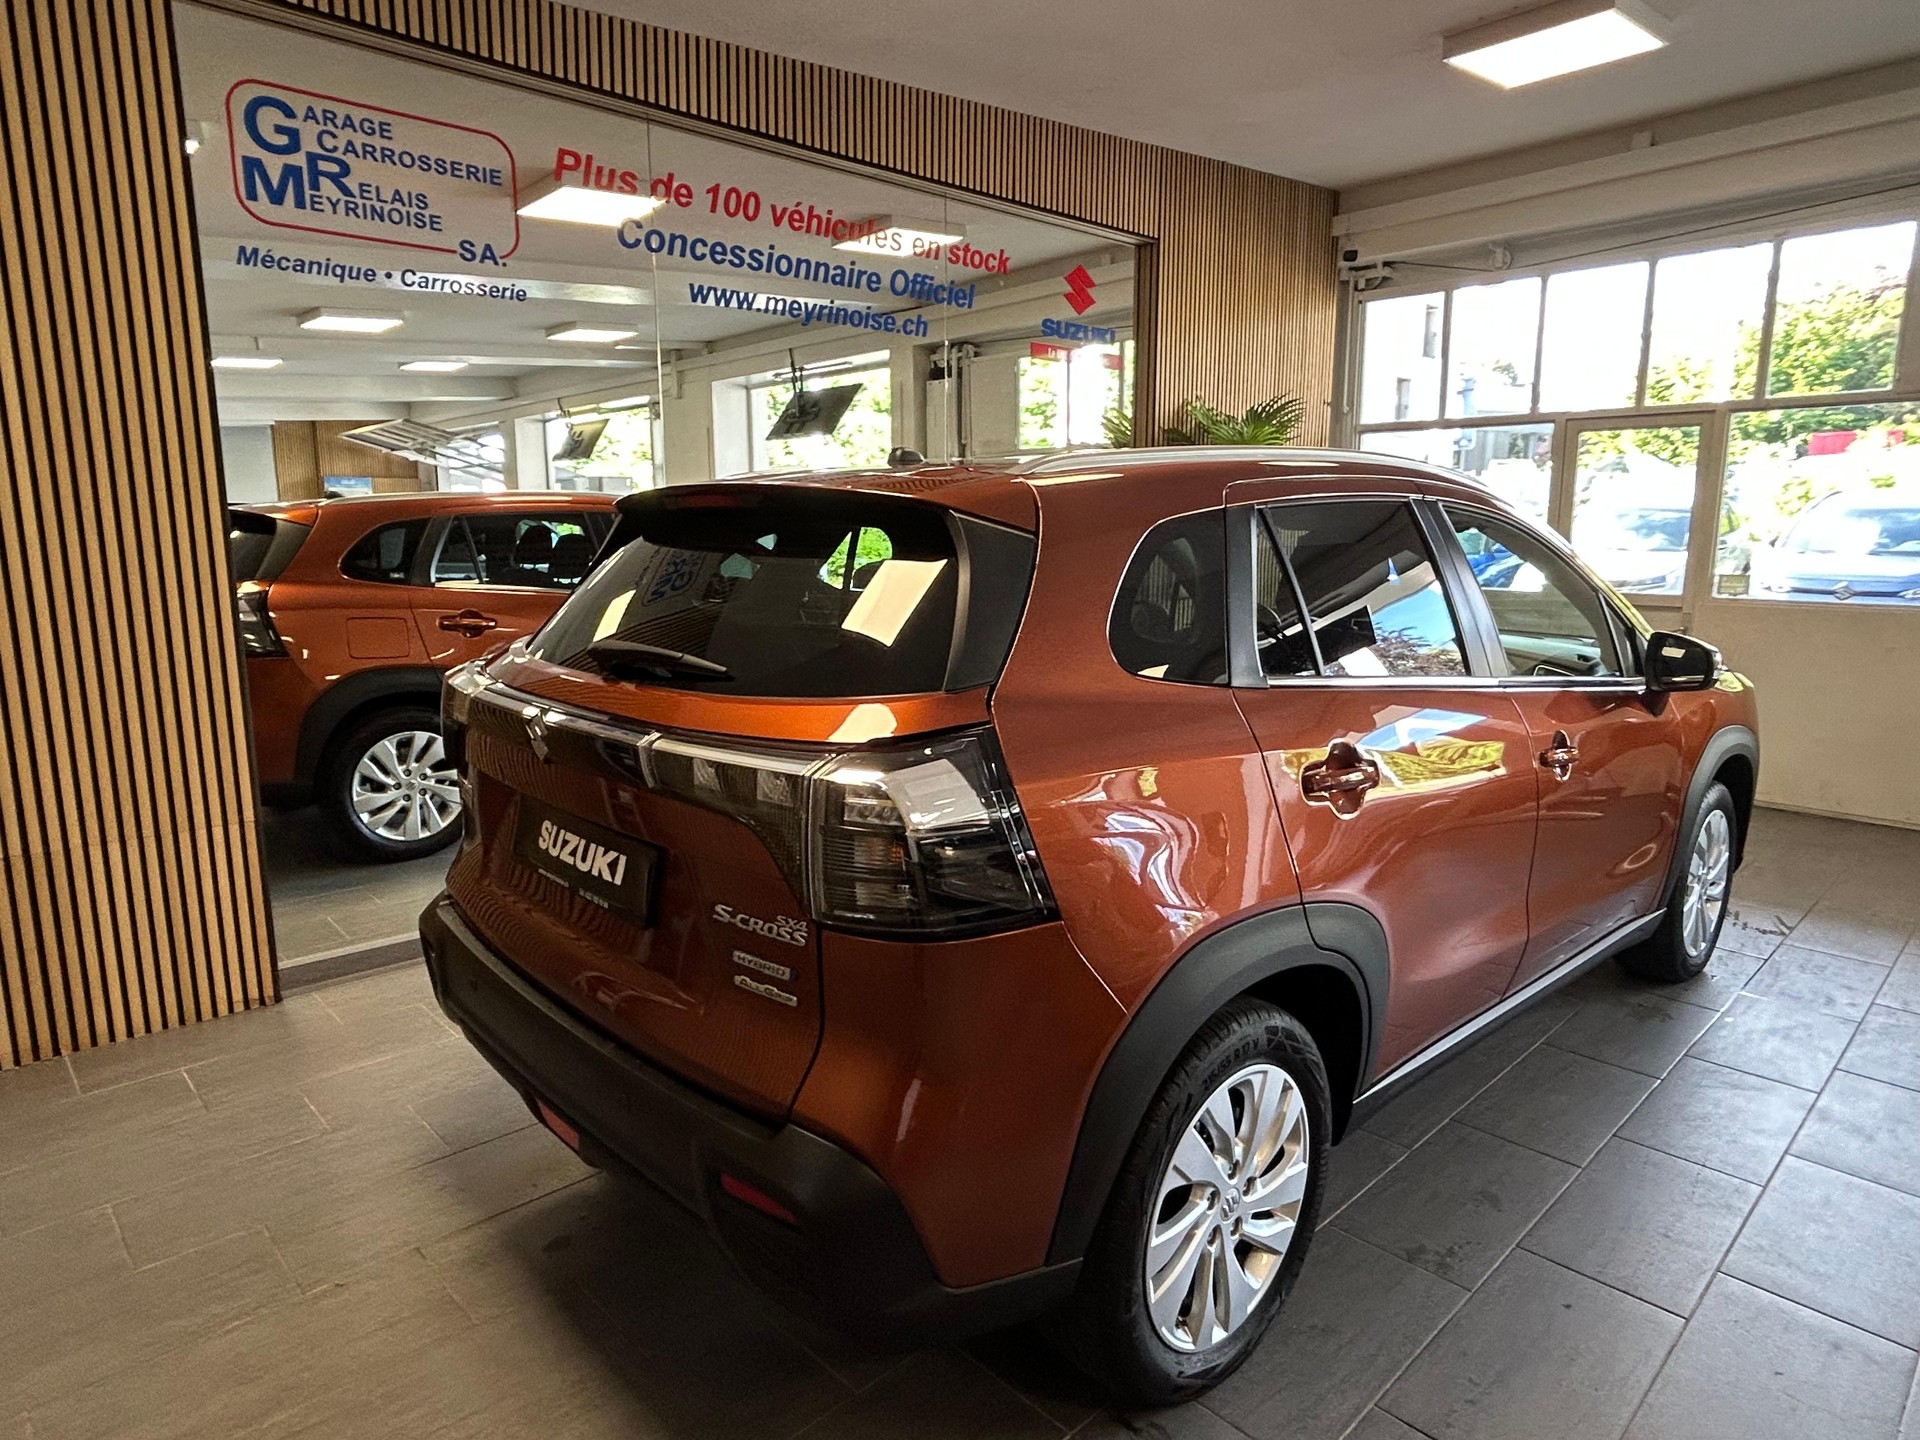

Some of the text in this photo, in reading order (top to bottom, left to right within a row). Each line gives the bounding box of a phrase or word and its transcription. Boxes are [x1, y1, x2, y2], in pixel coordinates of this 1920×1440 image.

[243, 95, 393, 155] GARAGE
[305, 151, 429, 210] RELAIS
[316, 129, 503, 187] CARROSSERIE
[241, 155, 443, 232] MEYRINOISE
[553, 147, 1011, 275] Plus de 100 véhicules en stock
[236, 245, 527, 302] Mécanique Carrosserie
[458, 239, 508, 267] SA.
[616, 217, 976, 310] Concessionnaire Officiel
[688, 281, 929, 338] www.meyrinoise.ch
[1041, 318, 1116, 344] SUZUKI
[538, 820, 627, 886] SUZUKI
[775, 915, 808, 932] SX4
[737, 954, 786, 977] HYBRID
